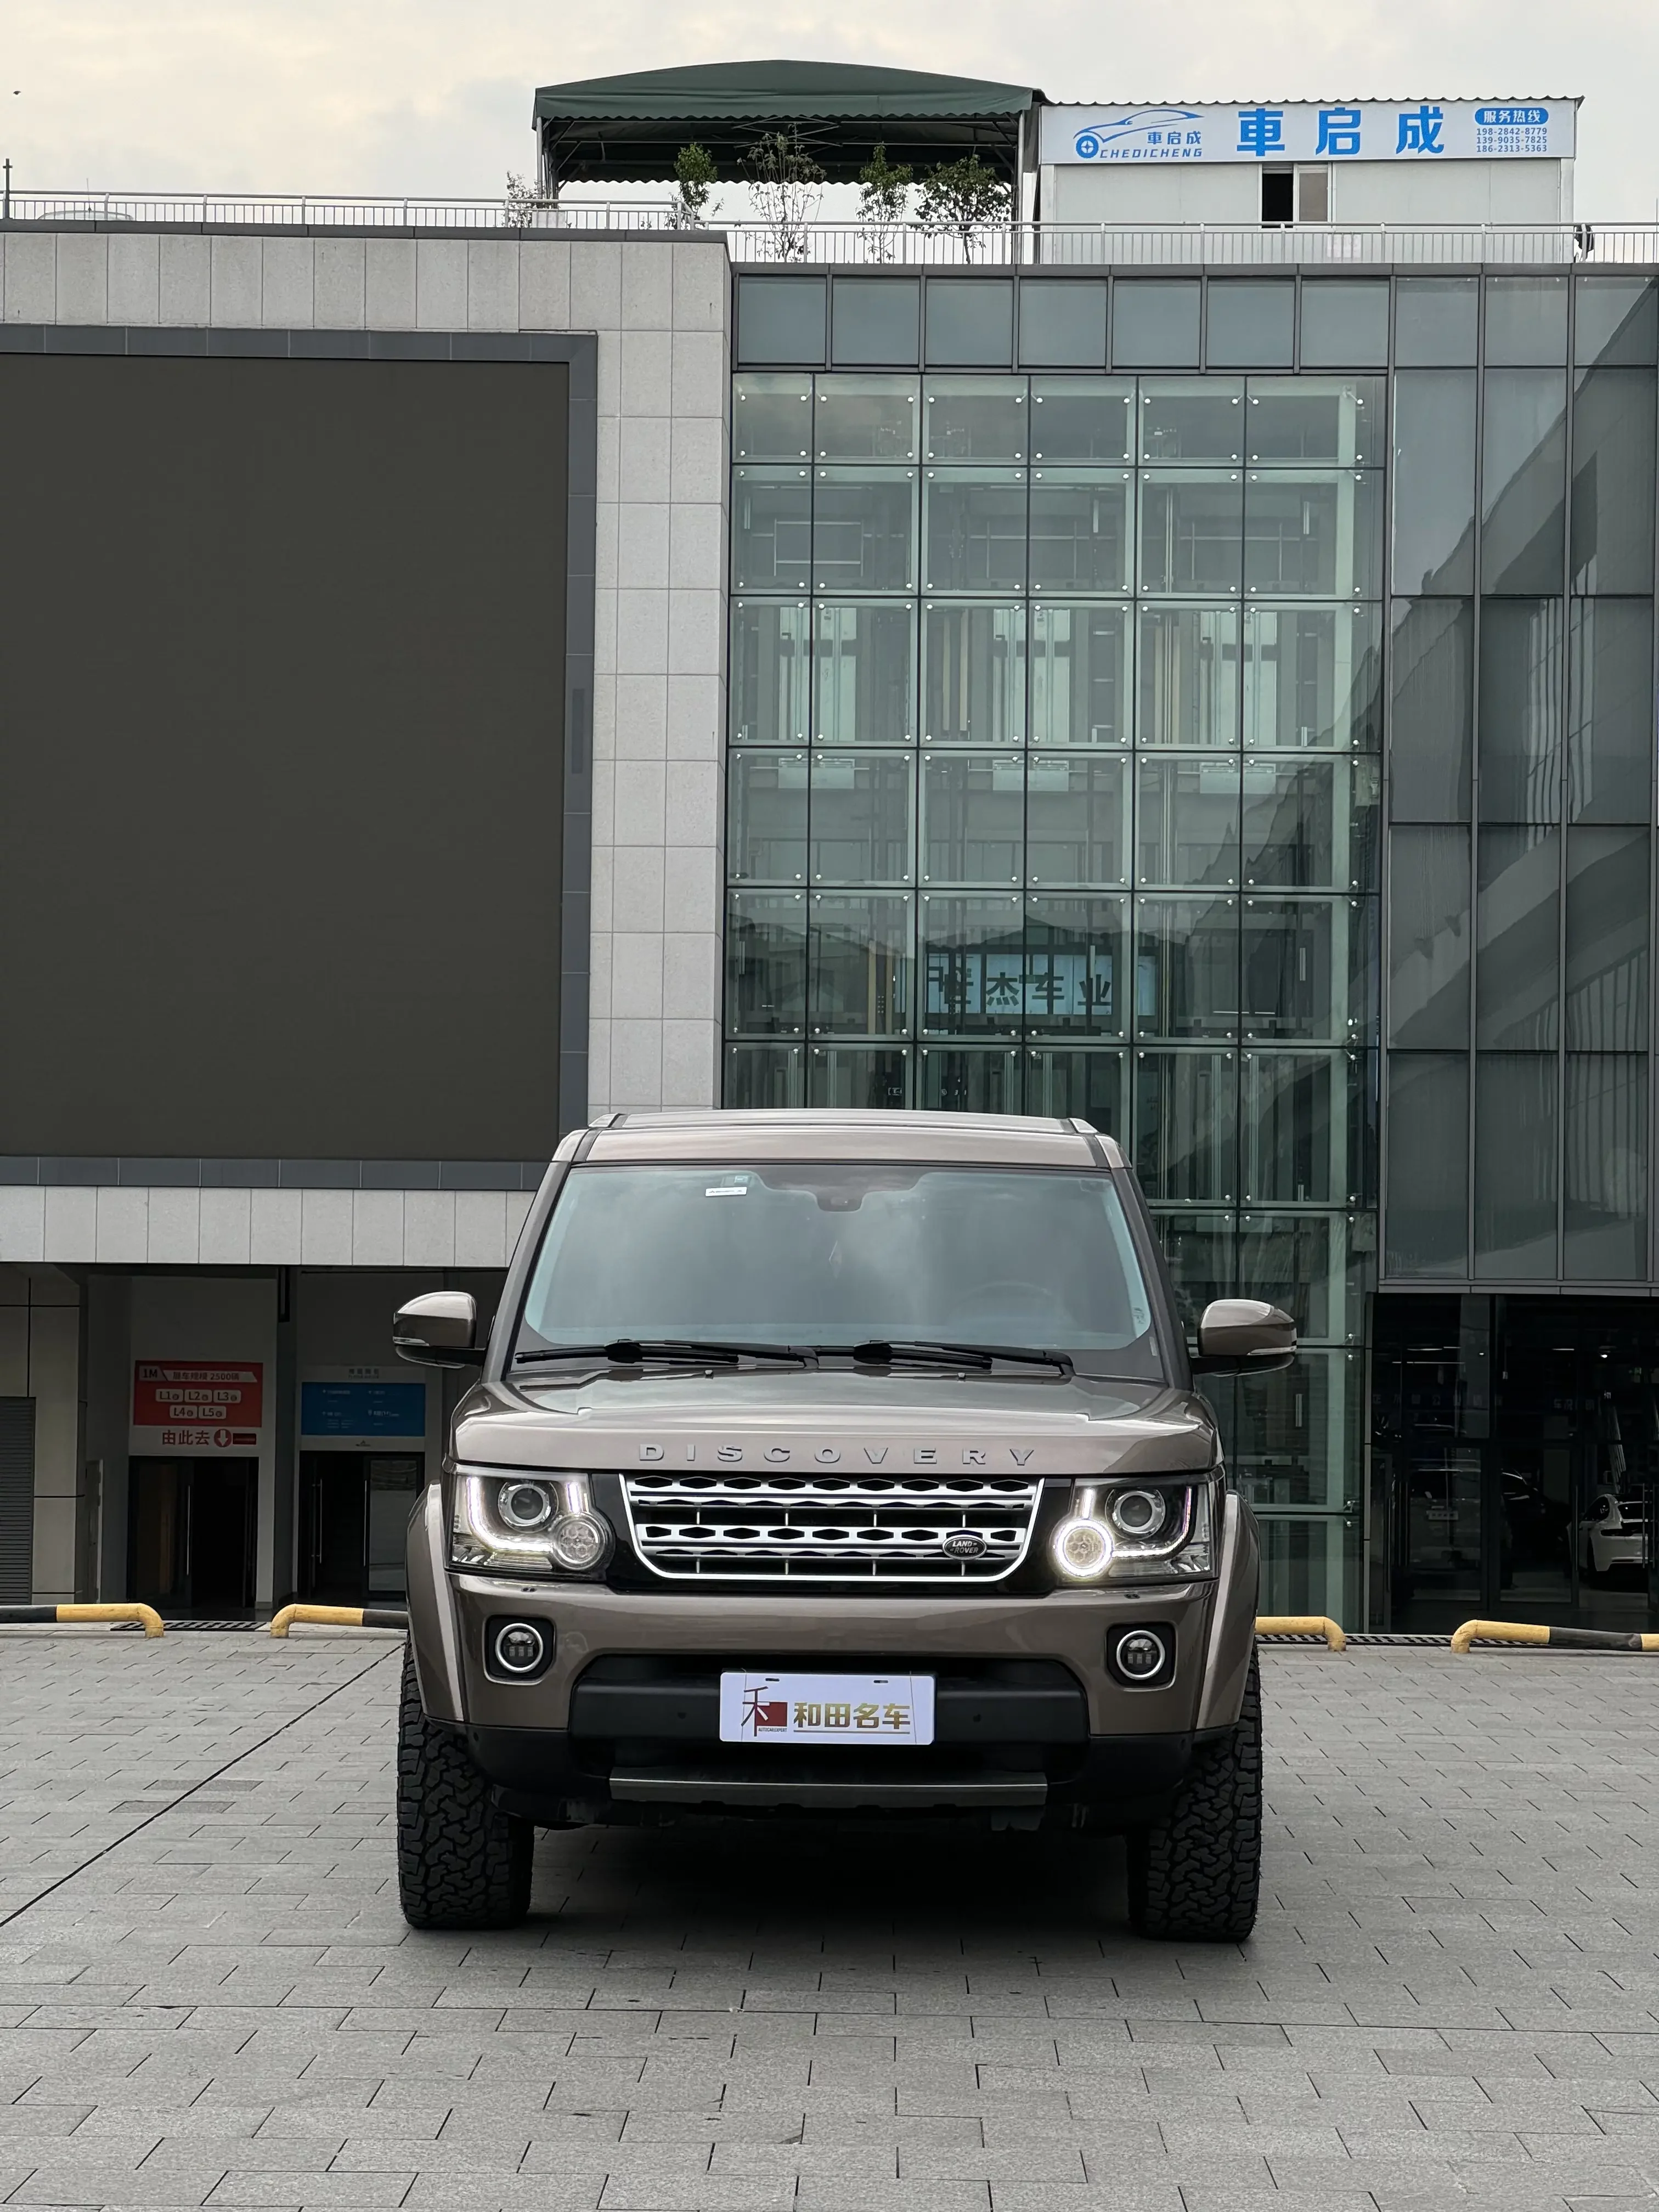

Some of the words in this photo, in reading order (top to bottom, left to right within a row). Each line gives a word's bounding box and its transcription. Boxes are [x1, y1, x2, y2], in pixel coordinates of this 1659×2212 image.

[1483, 110, 1541, 123] 服务热线
[1147, 131, 1201, 145] 車启成
[1237, 105, 1444, 156] 車启成
[162, 1429, 210, 1446] 由此去
[639, 1444, 1035, 1466] DISCOVERY
[793, 1702, 911, 1730] 和田名车
